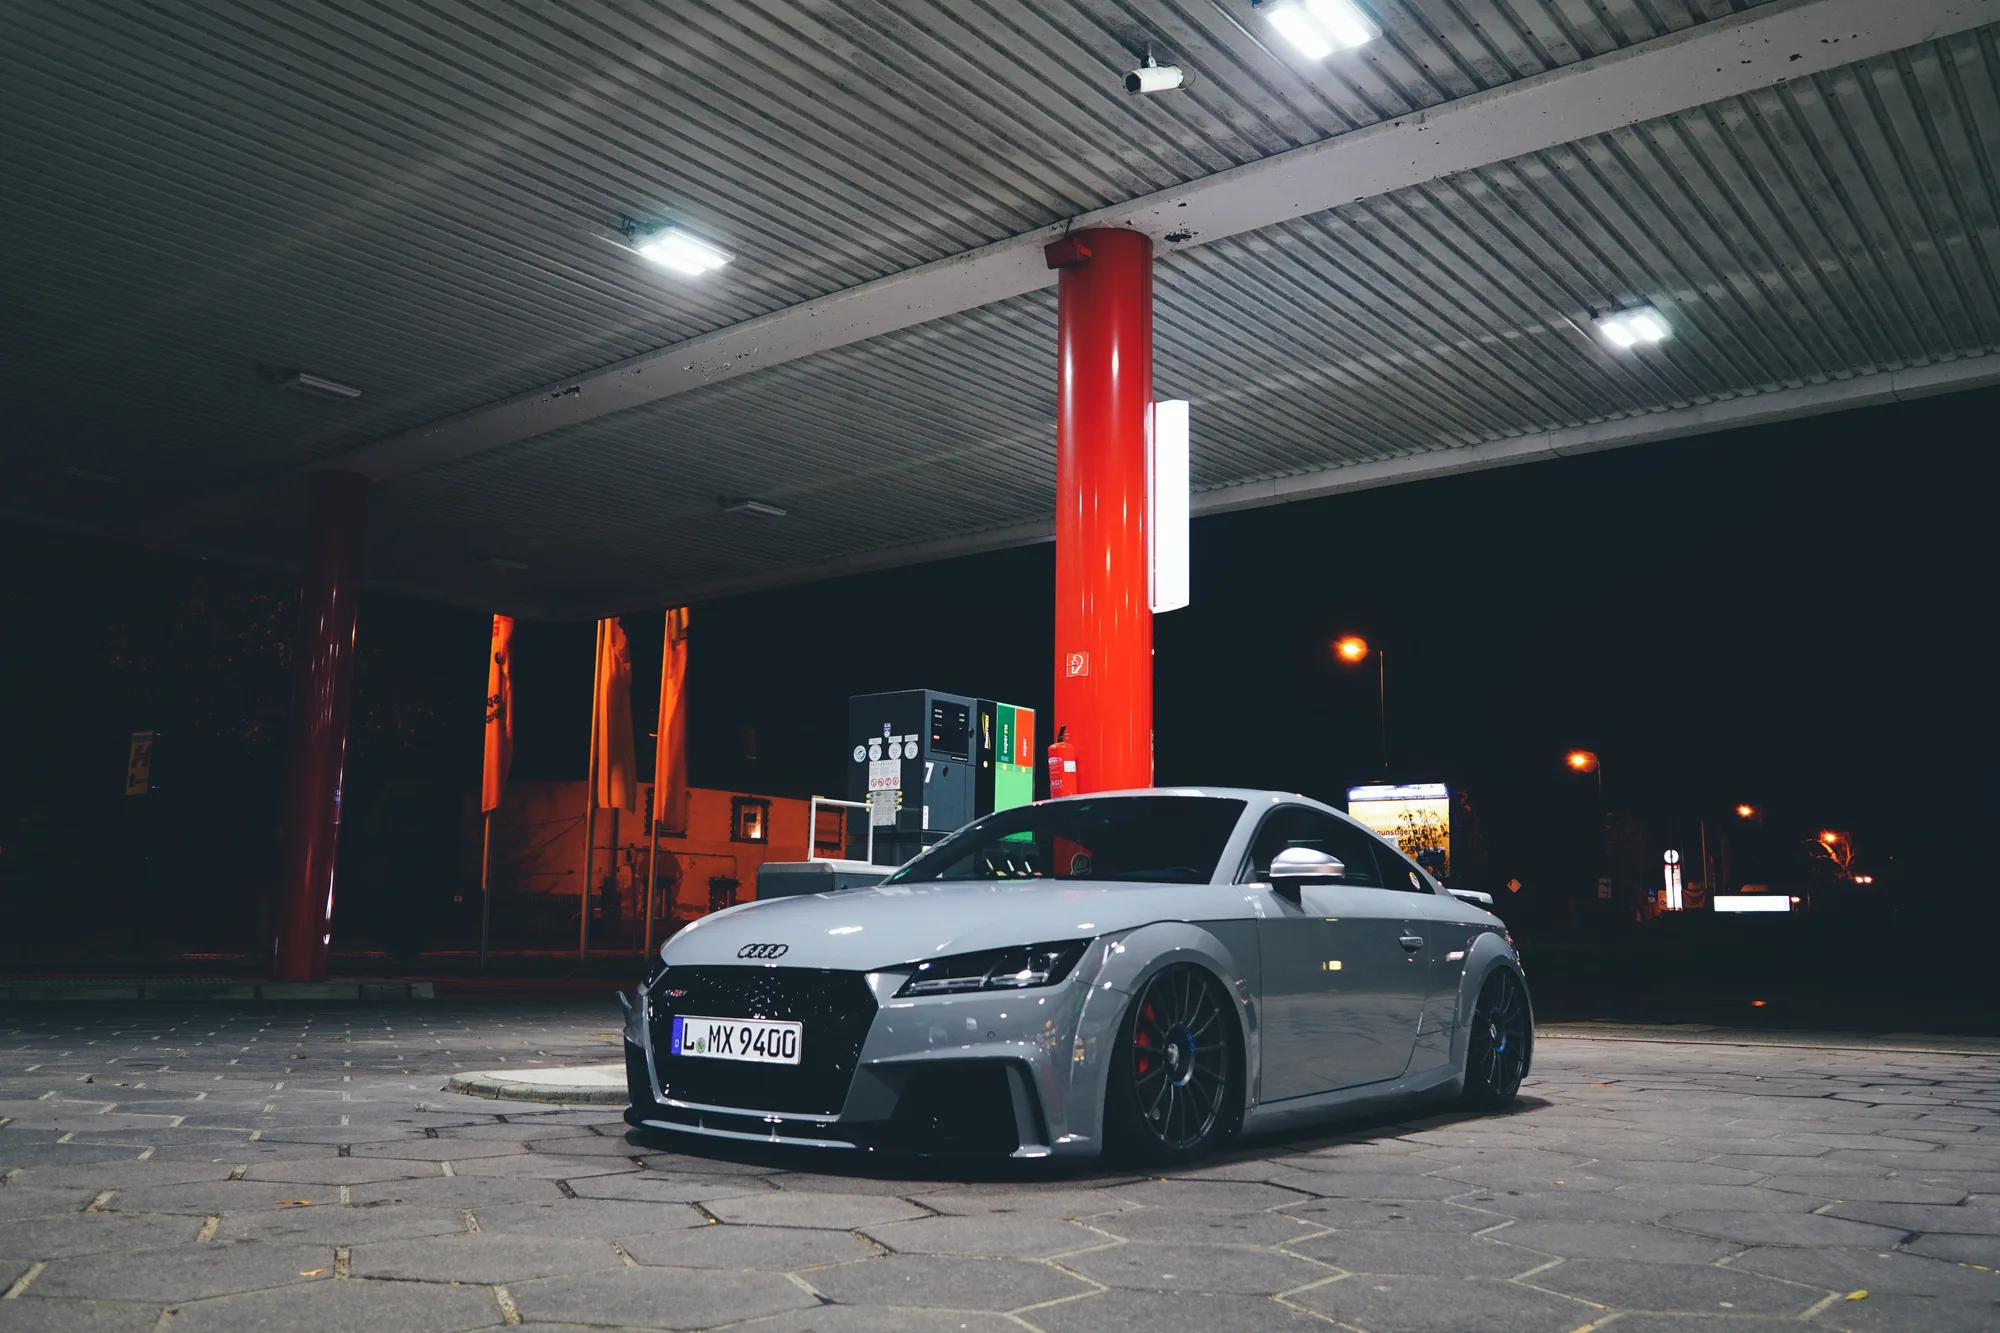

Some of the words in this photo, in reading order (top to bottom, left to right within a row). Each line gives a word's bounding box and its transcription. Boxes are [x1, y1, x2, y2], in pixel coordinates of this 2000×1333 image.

[924, 761, 935, 783] 7
[683, 1022, 695, 1050] L
[707, 1024, 734, 1054] MX
[740, 1027, 797, 1059] 9400
